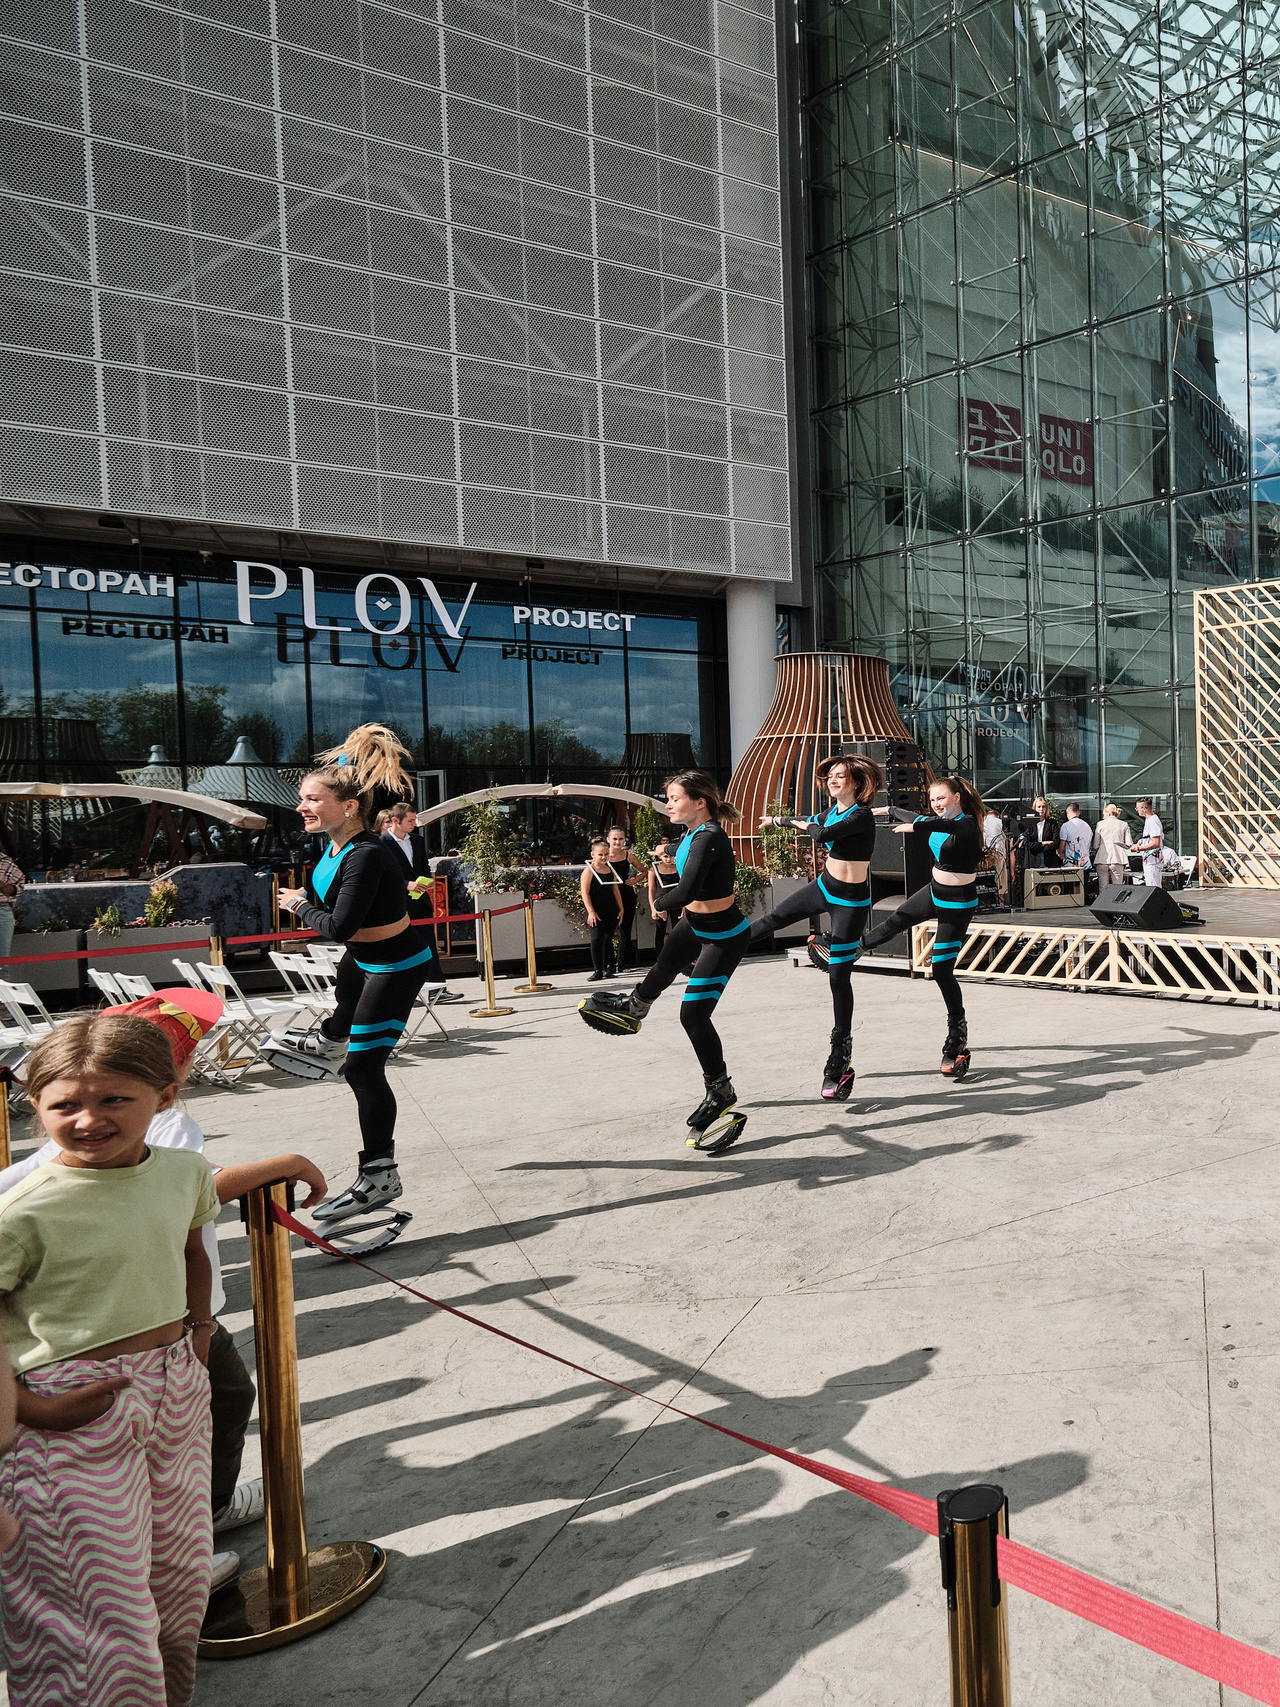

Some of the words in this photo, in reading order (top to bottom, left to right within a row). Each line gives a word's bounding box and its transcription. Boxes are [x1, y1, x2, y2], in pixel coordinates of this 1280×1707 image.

[1042, 423, 1080, 450] UNI
[1042, 449, 1086, 475] QLO
[232, 560, 478, 639] PLOV
[513, 605, 636, 632] PROJECT
